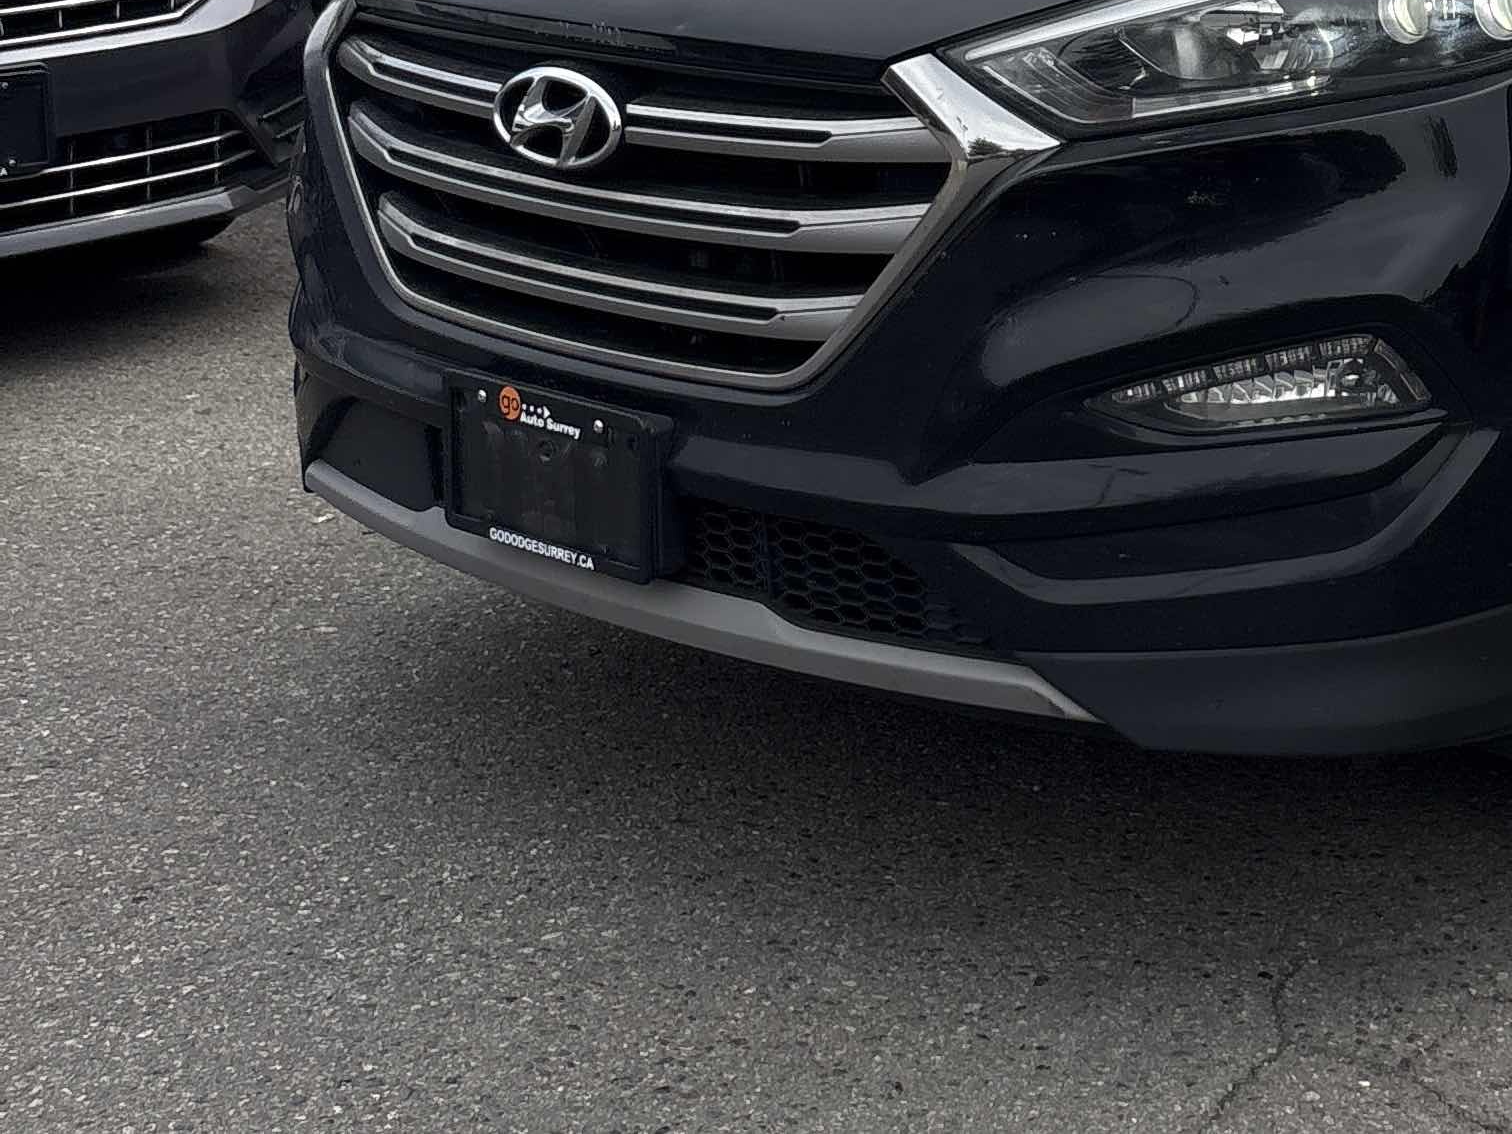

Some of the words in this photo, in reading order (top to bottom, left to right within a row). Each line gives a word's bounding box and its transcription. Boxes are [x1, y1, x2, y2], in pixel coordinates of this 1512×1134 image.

[520, 412, 545, 429] Auto
[546, 417, 581, 440] Surrey
[489, 527, 594, 571] GODODGESURREY.CA
